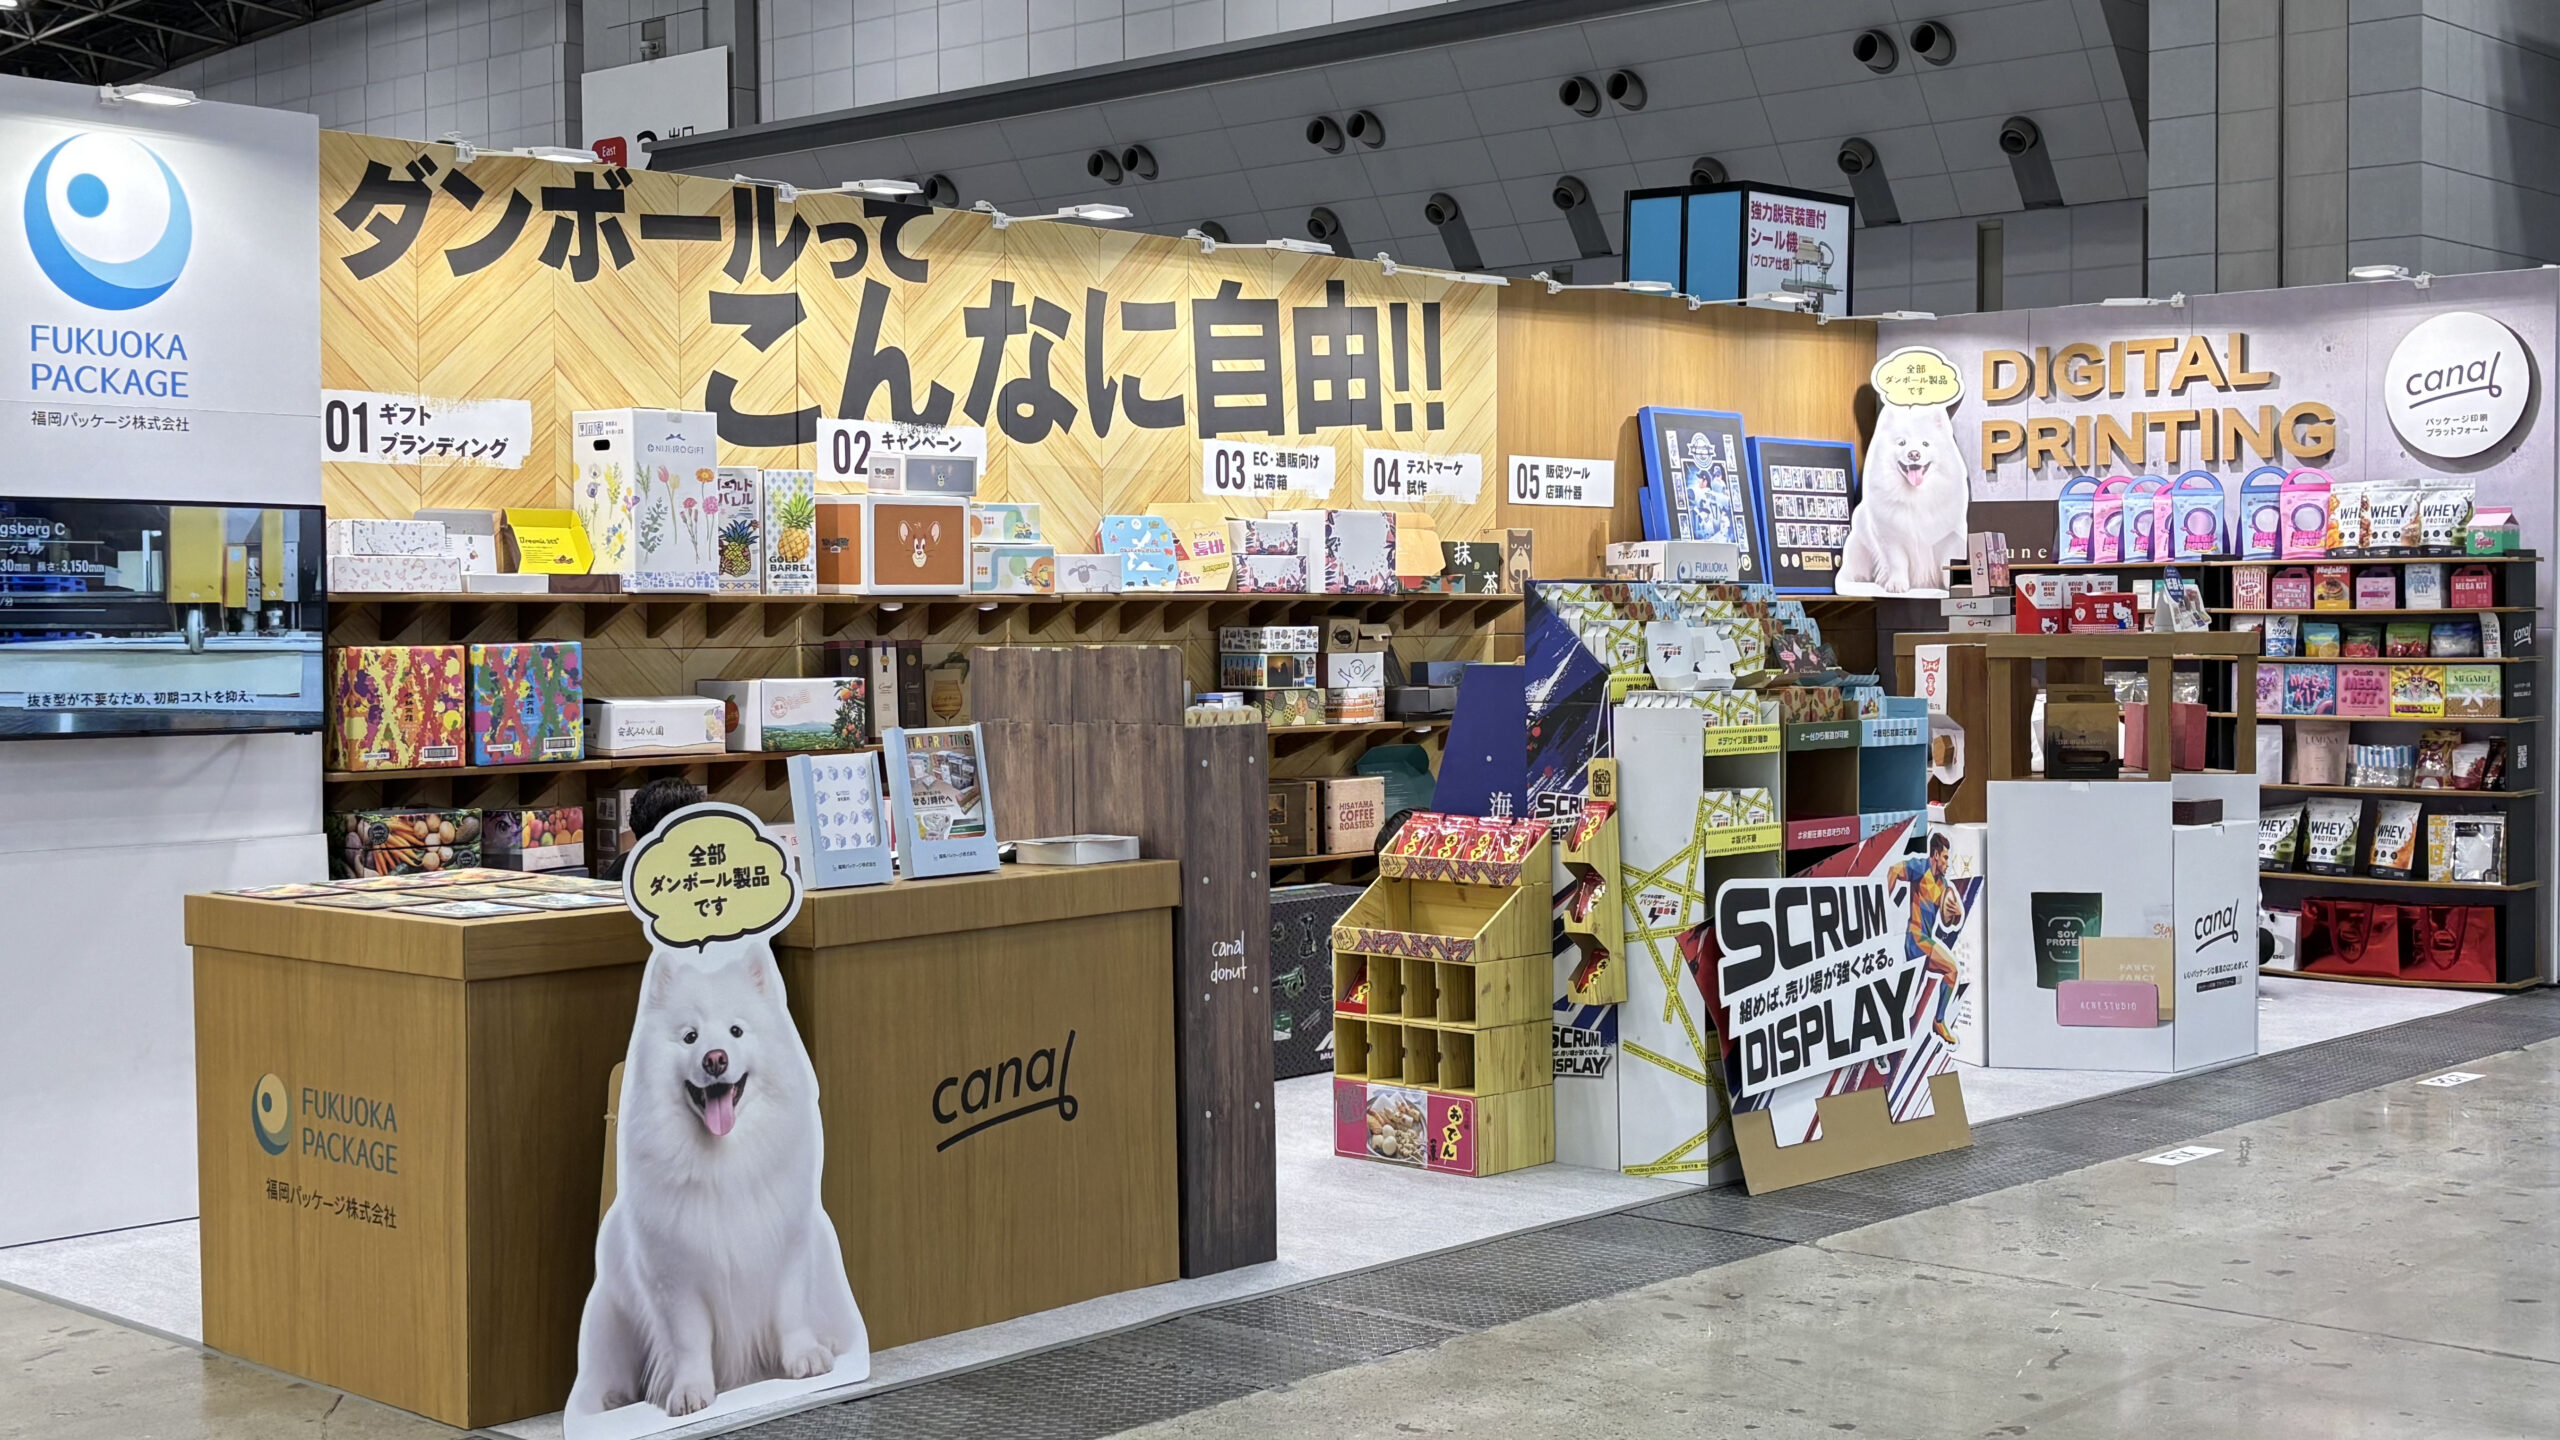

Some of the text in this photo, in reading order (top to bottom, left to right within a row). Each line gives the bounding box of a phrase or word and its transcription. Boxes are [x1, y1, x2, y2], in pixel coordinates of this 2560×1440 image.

[602, 145, 616, 157] East
[333, 155, 934, 283] ダンボールって
[1751, 200, 1827, 230] 強力脱気装置付
[1750, 227, 1798, 252] シール機
[31, 325, 188, 361] FUKUOKA
[704, 277, 1445, 448] こんなに自由!!
[1906, 364, 1926, 374] 全部
[1982, 333, 2274, 402] DIGITAL
[31, 363, 189, 398] PACKAGE
[1885, 375, 1947, 385] ダンボール製品
[2406, 351, 2502, 409] canal
[1908, 387, 1925, 395] です
[31, 411, 190, 432] 福岡パッケージ株式会社
[379, 402, 432, 426] ギフト
[2426, 414, 2488, 426] パッケージ印刷
[326, 400, 368, 453] 01
[1982, 401, 2337, 471] PRINTING
[2426, 425, 2488, 437] プラットフォーム
[380, 432, 508, 458] ブランディング
[833, 429, 871, 475] 02
[881, 432, 962, 452] キャンペーン
[1215, 449, 1246, 489] 03
[1373, 457, 1401, 495] 04
[1406, 460, 1464, 476] テストマーケ
[1545, 464, 1591, 480] 販促ツール
[1253, 474, 1287, 490] 出荷箱
[1406, 480, 1427, 494] 試作
[1517, 463, 1540, 499] 05
[1545, 485, 1582, 500] 店頭什器
[2370, 505, 2409, 518] WHEY
[2422, 504, 2459, 517] WHEY
[54, 522, 66, 536] C
[769, 555, 799, 563] GOLD
[769, 564, 813, 572] BARREL
[1695, 562, 1728, 573] FUKUOKA
[2455, 582, 2487, 590] MEGA KIT
[2513, 622, 2532, 647] canal
[2289, 673, 2331, 690] MEGA
[2344, 677, 2383, 691] MEGA
[2454, 674, 2491, 683] MEGAKIT
[27, 689, 255, 707] 抜き型が不要なため、初期コストを抑え、
[2294, 687, 2321, 703] KIT
[927, 734, 970, 749] PRINTING
[1339, 800, 1374, 811] HISAYAMA
[1339, 808, 1375, 822] COFFEE
[1339, 819, 1375, 831] ROASTERS
[2311, 821, 2346, 836] WHEY
[2378, 824, 2405, 839] WHEY
[2314, 834, 2338, 842] PROTEIN
[2378, 838, 2399, 846] PROTEIN
[688, 843, 726, 867] 全部
[650, 865, 770, 896] ダンボール製品
[694, 896, 728, 917] です
[2057, 930, 2077, 938] SOY
[2194, 899, 2239, 953] canal
[1211, 929, 1245, 957] canal
[1720, 884, 1888, 997] SCRUM
[1210, 956, 1248, 984] donut
[1739, 948, 1894, 1025] 組めば、売り場が強くなる。
[1745, 966, 1916, 1087] DISPLAY
[932, 1029, 1079, 1152] canal
[302, 1087, 397, 1133] FUKUOKA
[1442, 1106, 1462, 1158] おでん
[302, 1127, 398, 1175] PACKAGE
[266, 1177, 397, 1229] 福岡パッケージ株式会社
